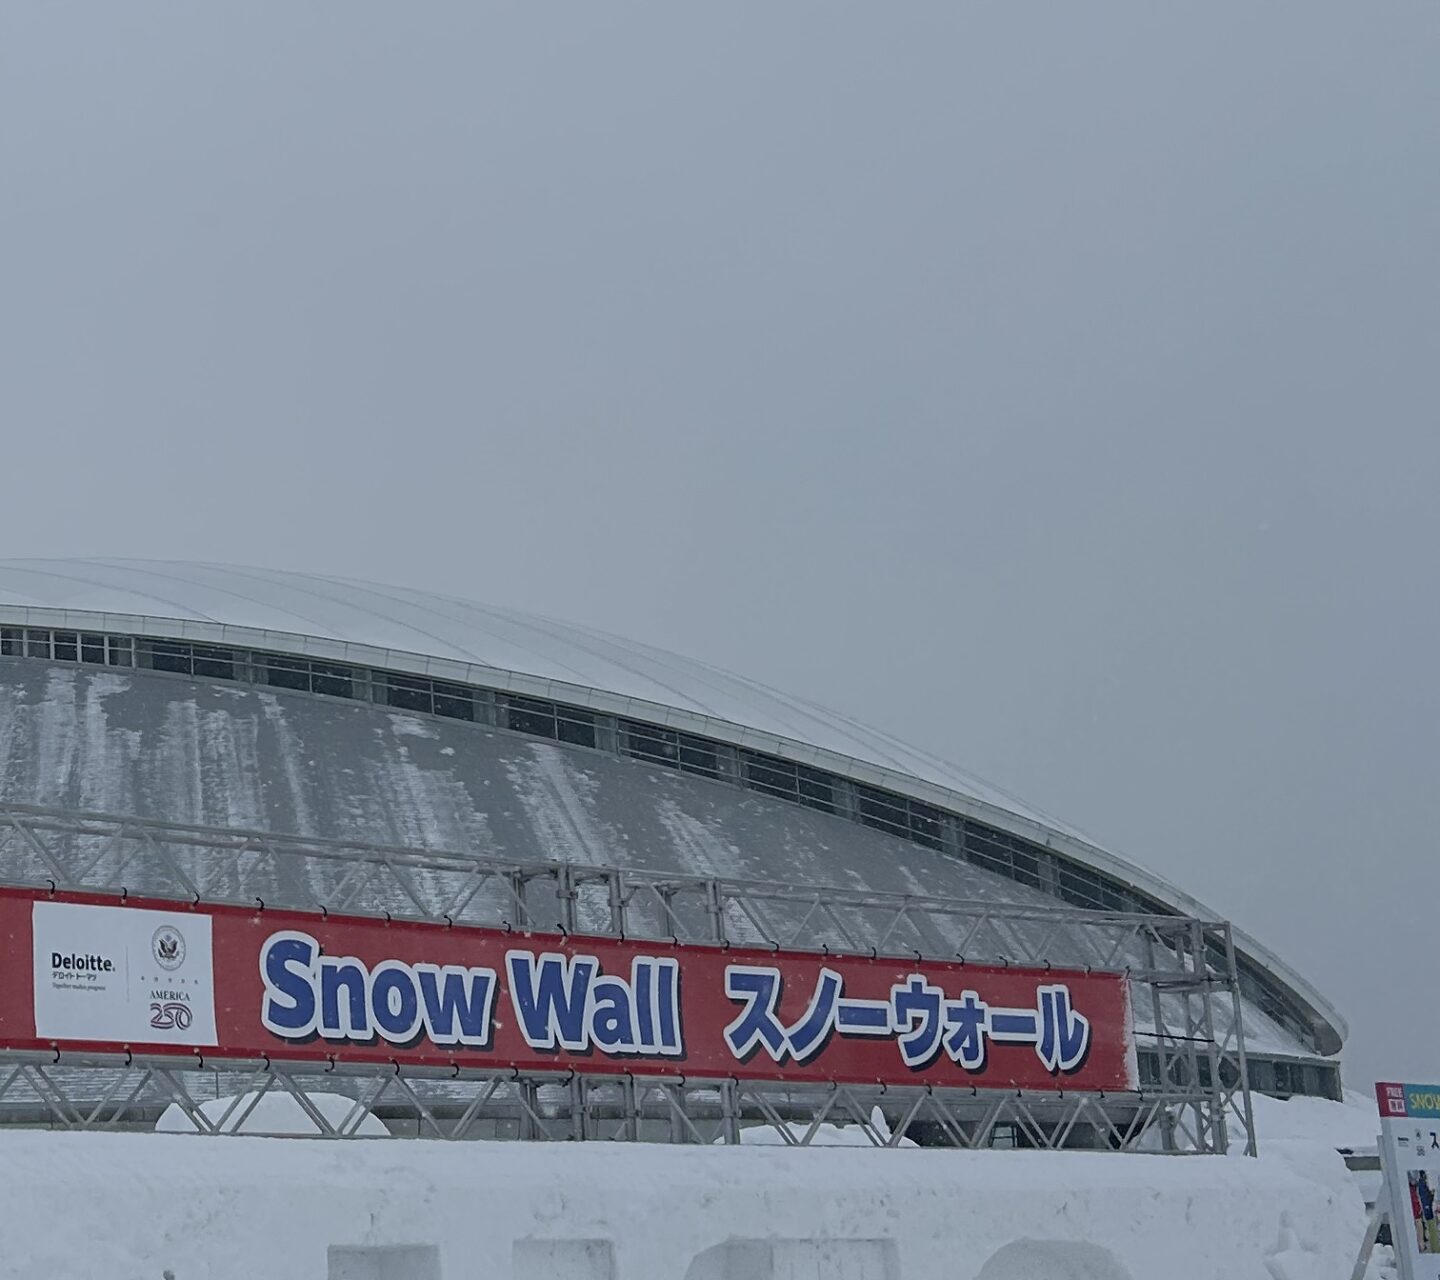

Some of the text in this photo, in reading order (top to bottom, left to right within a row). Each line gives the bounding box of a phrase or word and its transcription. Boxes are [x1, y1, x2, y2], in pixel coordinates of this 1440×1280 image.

[52, 952, 116, 972] Deloitte.
[150, 990, 190, 1001] AMERICA
[260, 931, 496, 1044] Snow
[506, 950, 682, 1055] Wall
[150, 1002, 193, 1030] 250
[724, 965, 1090, 1071] スノーウォール
